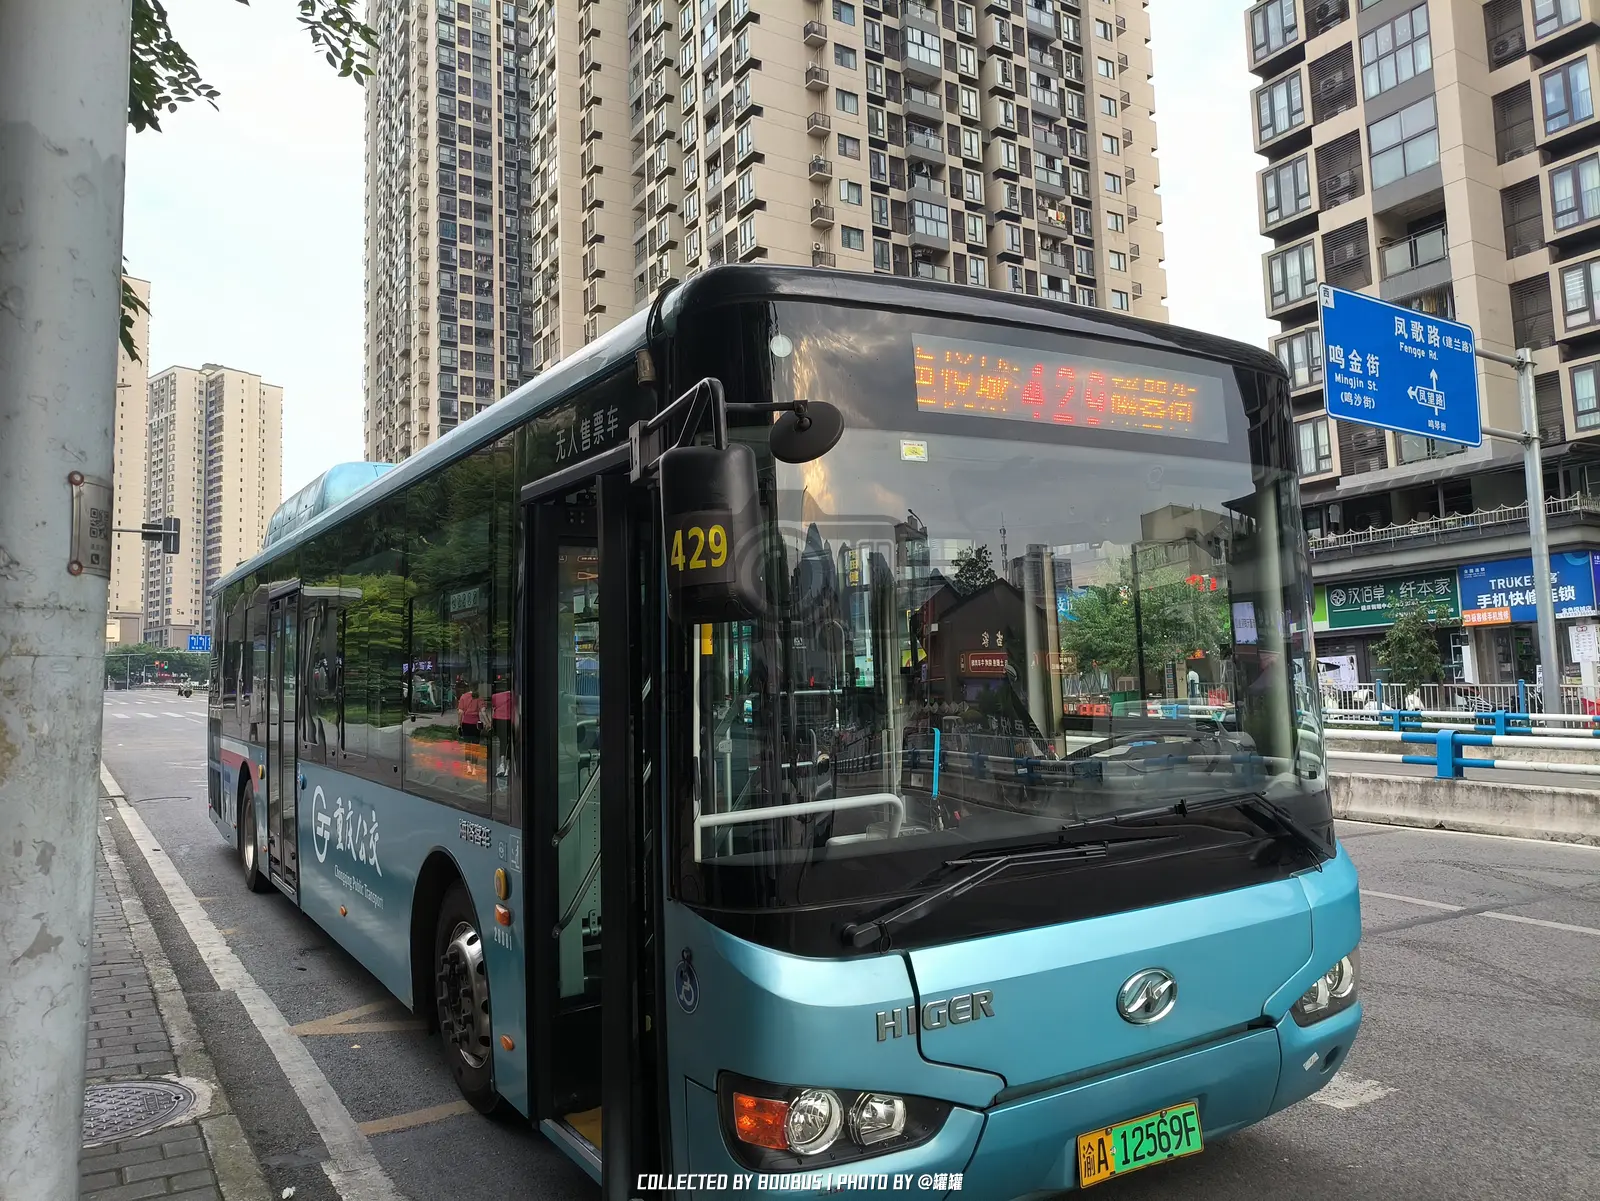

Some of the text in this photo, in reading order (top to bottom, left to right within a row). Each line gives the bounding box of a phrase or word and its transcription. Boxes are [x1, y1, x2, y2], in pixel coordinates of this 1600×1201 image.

[1394, 316, 1440, 348] 凤歌路
[1399, 342, 1439, 361] Fengge Rd.
[1328, 344, 1380, 378] 鸣金街
[1334, 372, 1378, 391] Mingjin St.
[1021, 362, 1106, 425] 429
[1340, 391, 1376, 410] (鸣沙街)
[1418, 389, 1443, 407] 凤望路
[555, 405, 619, 463] 无人售票车
[670, 524, 728, 572] 429
[333, 796, 383, 878] 重庆公交
[334, 864, 384, 910] Chongqing Public Transport
[876, 989, 995, 1042] HIGER
[1120, 1109, 1197, 1166] 12569F
